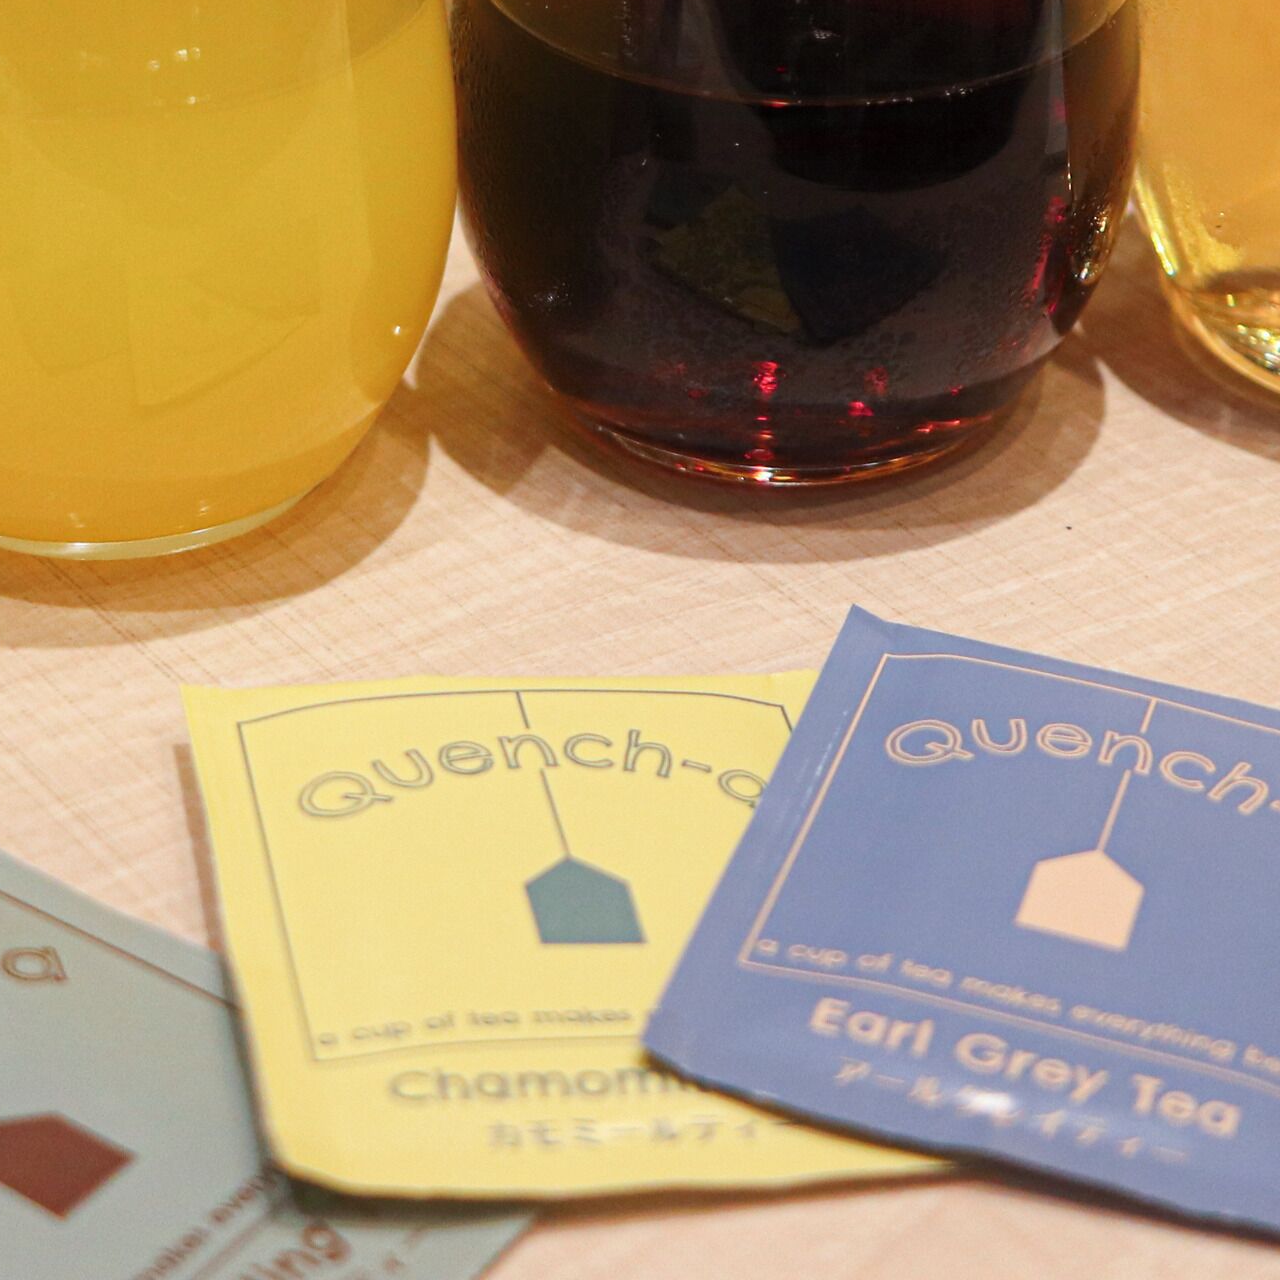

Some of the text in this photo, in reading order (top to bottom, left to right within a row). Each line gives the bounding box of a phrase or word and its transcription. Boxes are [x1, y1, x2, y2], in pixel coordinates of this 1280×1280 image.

[757, 938, 780, 956] a
[788, 943, 849, 968] cup
[856, 951, 895, 972] of
[901, 958, 954, 988] tea
[960, 975, 1063, 1016] makes
[351, 1021, 414, 1043] cup
[425, 1010, 457, 1031] of
[466, 1009, 522, 1027] tea
[530, 1008, 633, 1025] makes
[389, 1066, 692, 1102] Chamom
[809, 995, 1243, 1138] Earl Grey Tea
